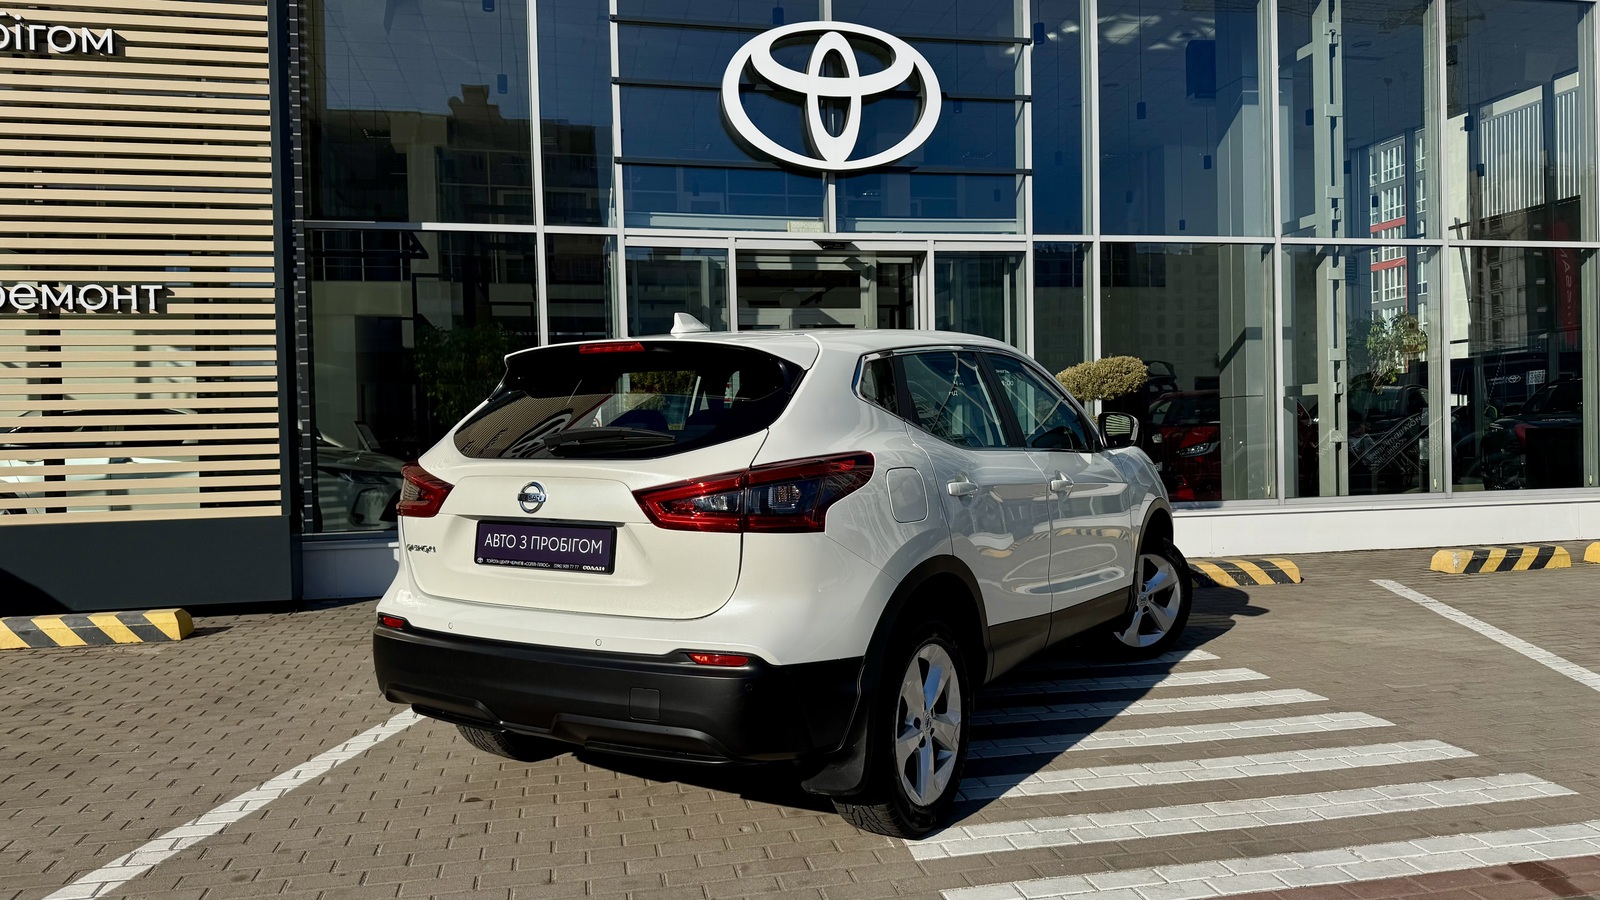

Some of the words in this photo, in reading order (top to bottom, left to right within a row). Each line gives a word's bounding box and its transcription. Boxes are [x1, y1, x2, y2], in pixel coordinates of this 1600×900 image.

[484, 533, 516, 548] АВТО
[519, 535, 527, 549] З
[530, 535, 603, 554] ПРОБІГОМ
